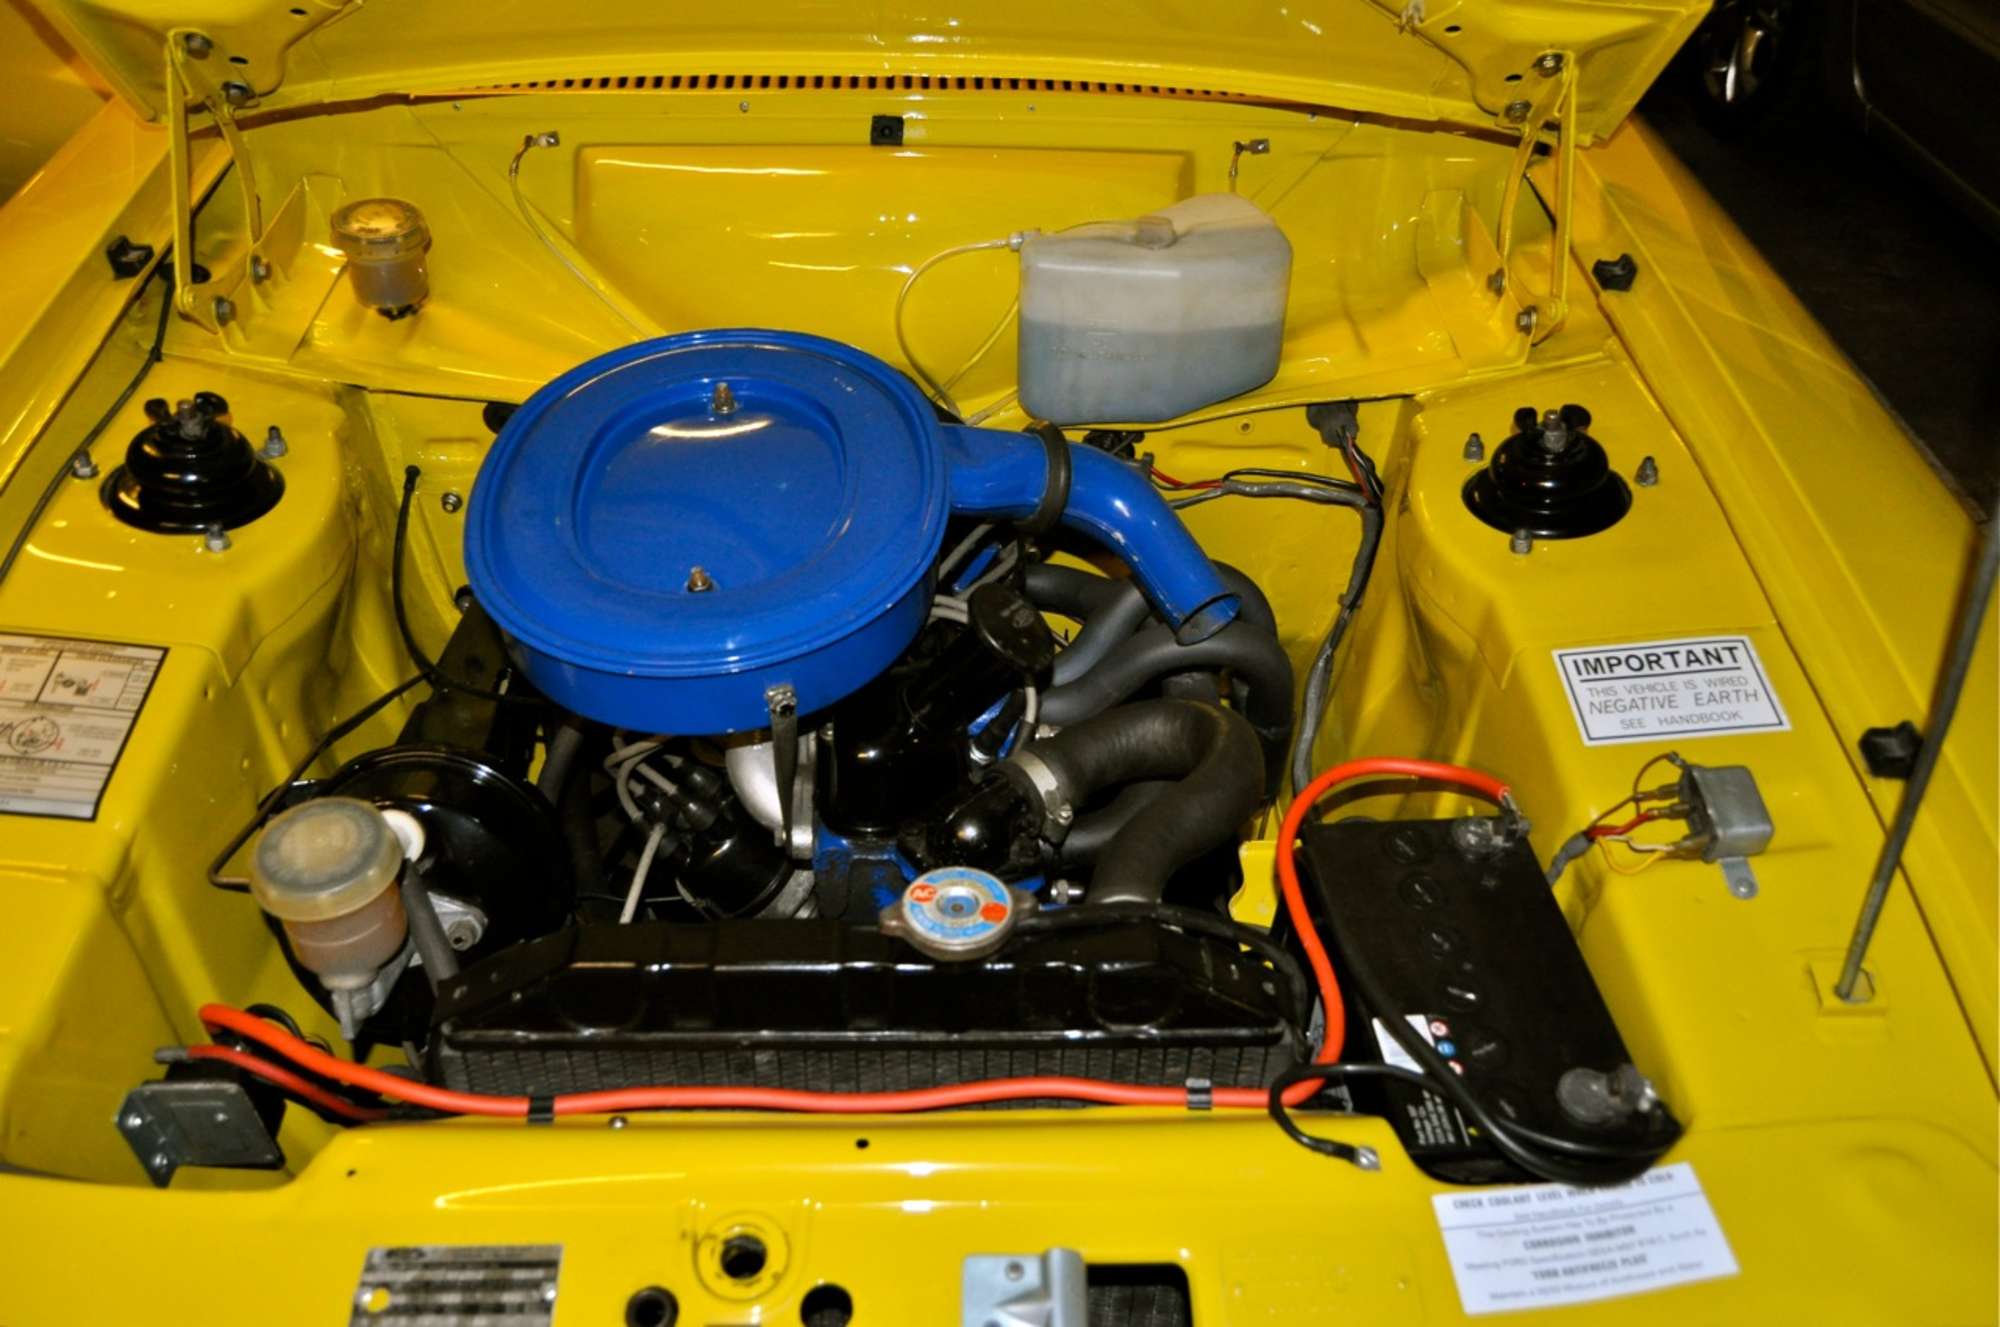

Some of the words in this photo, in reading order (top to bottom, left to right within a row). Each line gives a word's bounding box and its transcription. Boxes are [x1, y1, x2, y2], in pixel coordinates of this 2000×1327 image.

[1572, 646, 1739, 676] IMPORTANT
[1587, 686, 1618, 698] THIS
[1623, 681, 1678, 695] VEHICLE
[1683, 679, 1697, 690] IS
[1704, 676, 1749, 688] WIRED
[1589, 694, 1680, 715] NEGATIVE
[1693, 689, 1759, 706] EARTH
[1620, 718, 1646, 730] SEE
[1658, 711, 1743, 726] HANDBOOK
